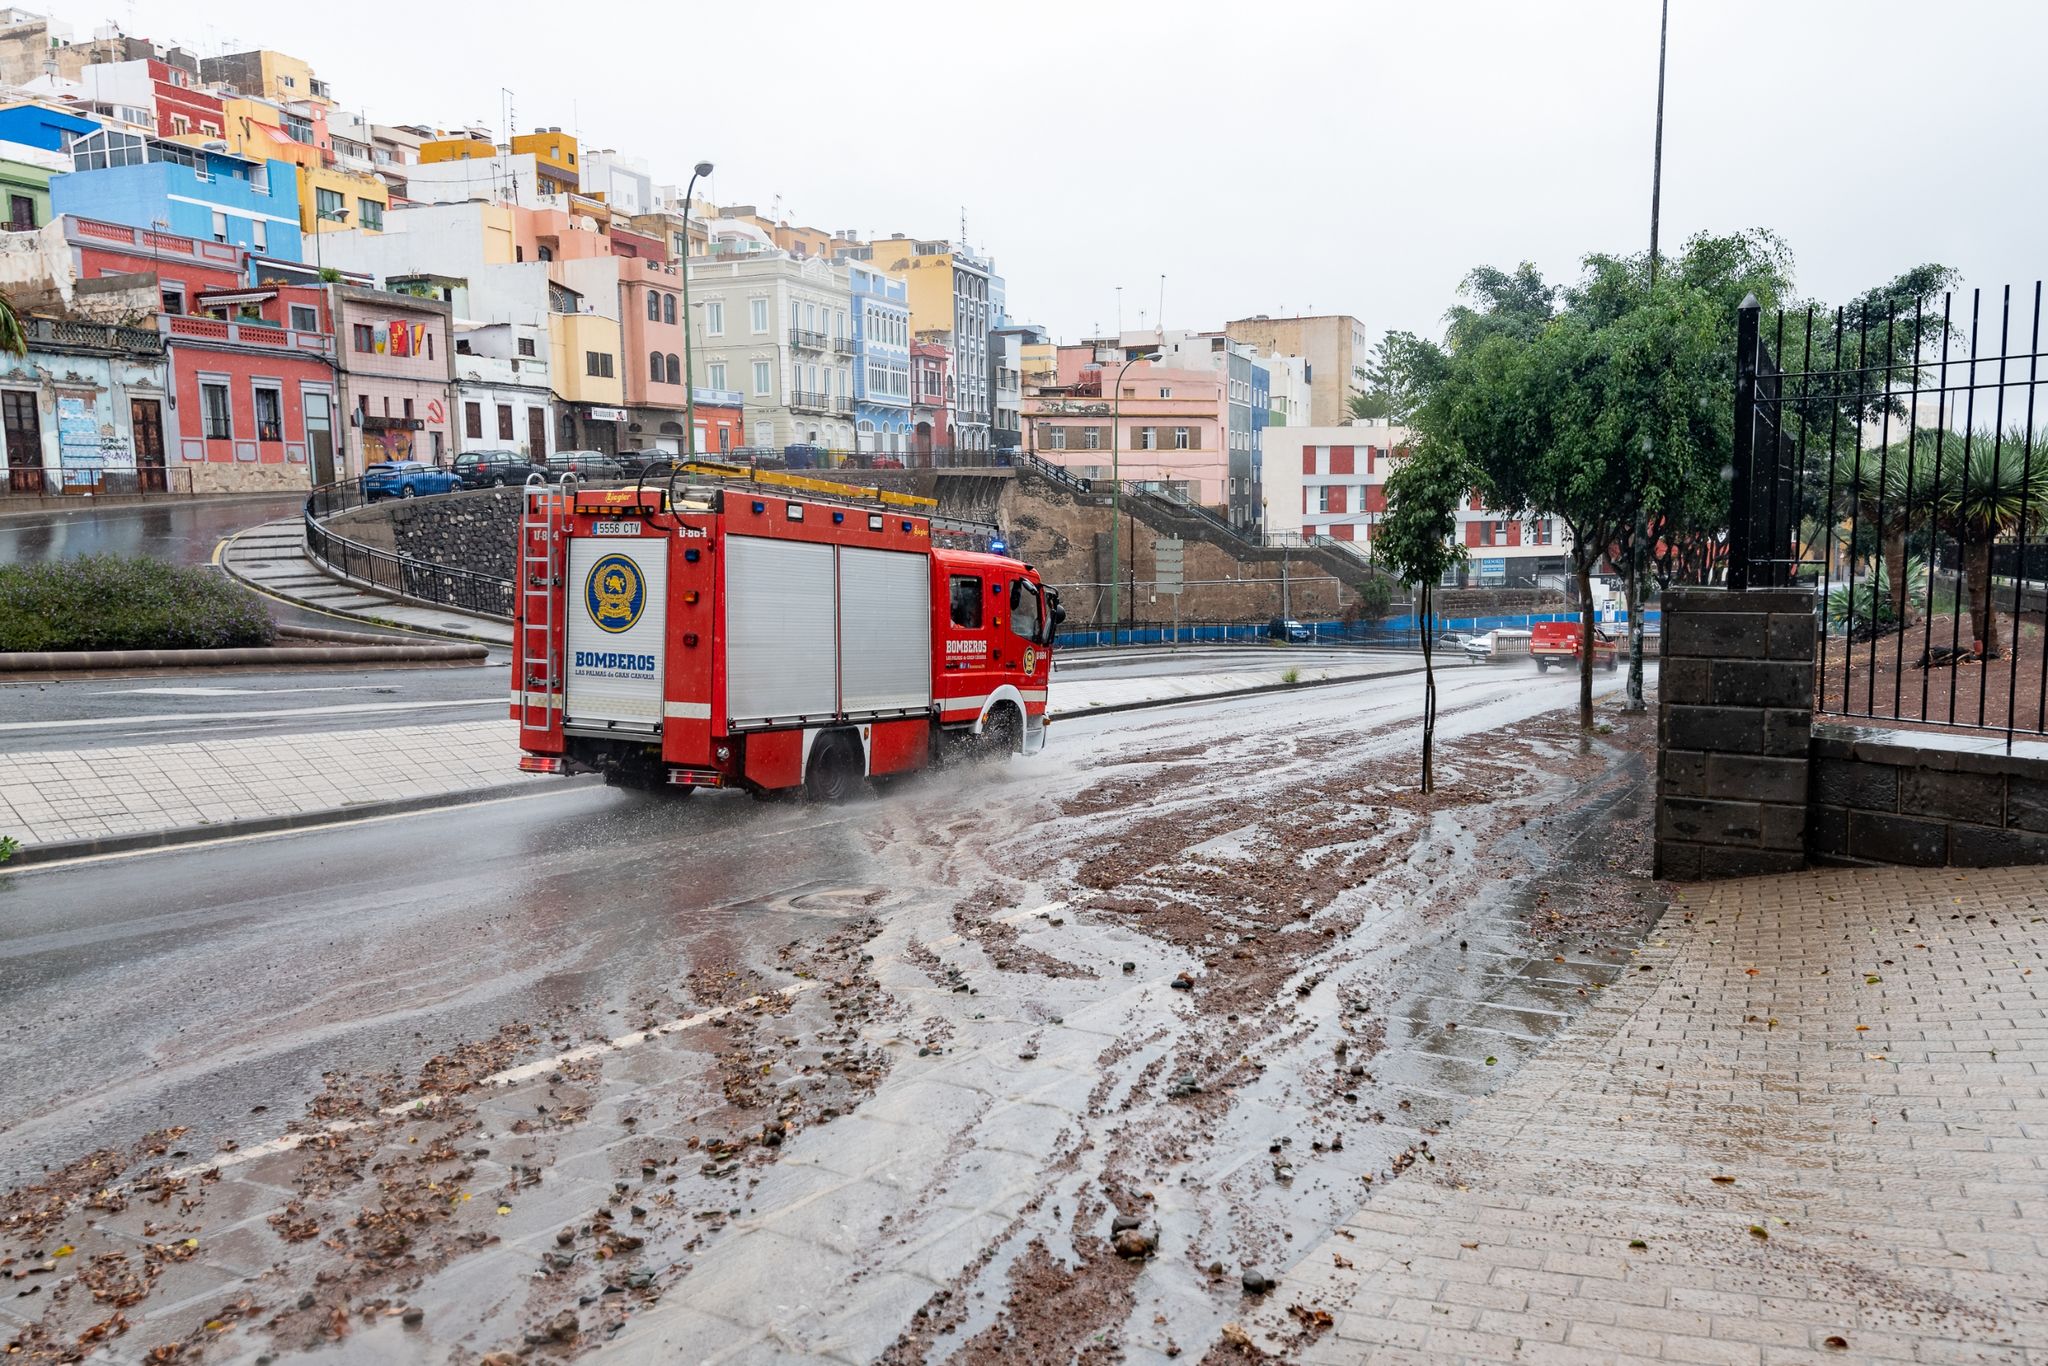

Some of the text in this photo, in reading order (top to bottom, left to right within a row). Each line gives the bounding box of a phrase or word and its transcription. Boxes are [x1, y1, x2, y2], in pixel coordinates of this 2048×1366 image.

[605, 493, 632, 503] Ziegler
[599, 523, 640, 533] 5556 CTV
[533, 529, 559, 541] U-84
[946, 640, 987, 653] BOMBEROS
[575, 651, 655, 671] BOMBEROS
